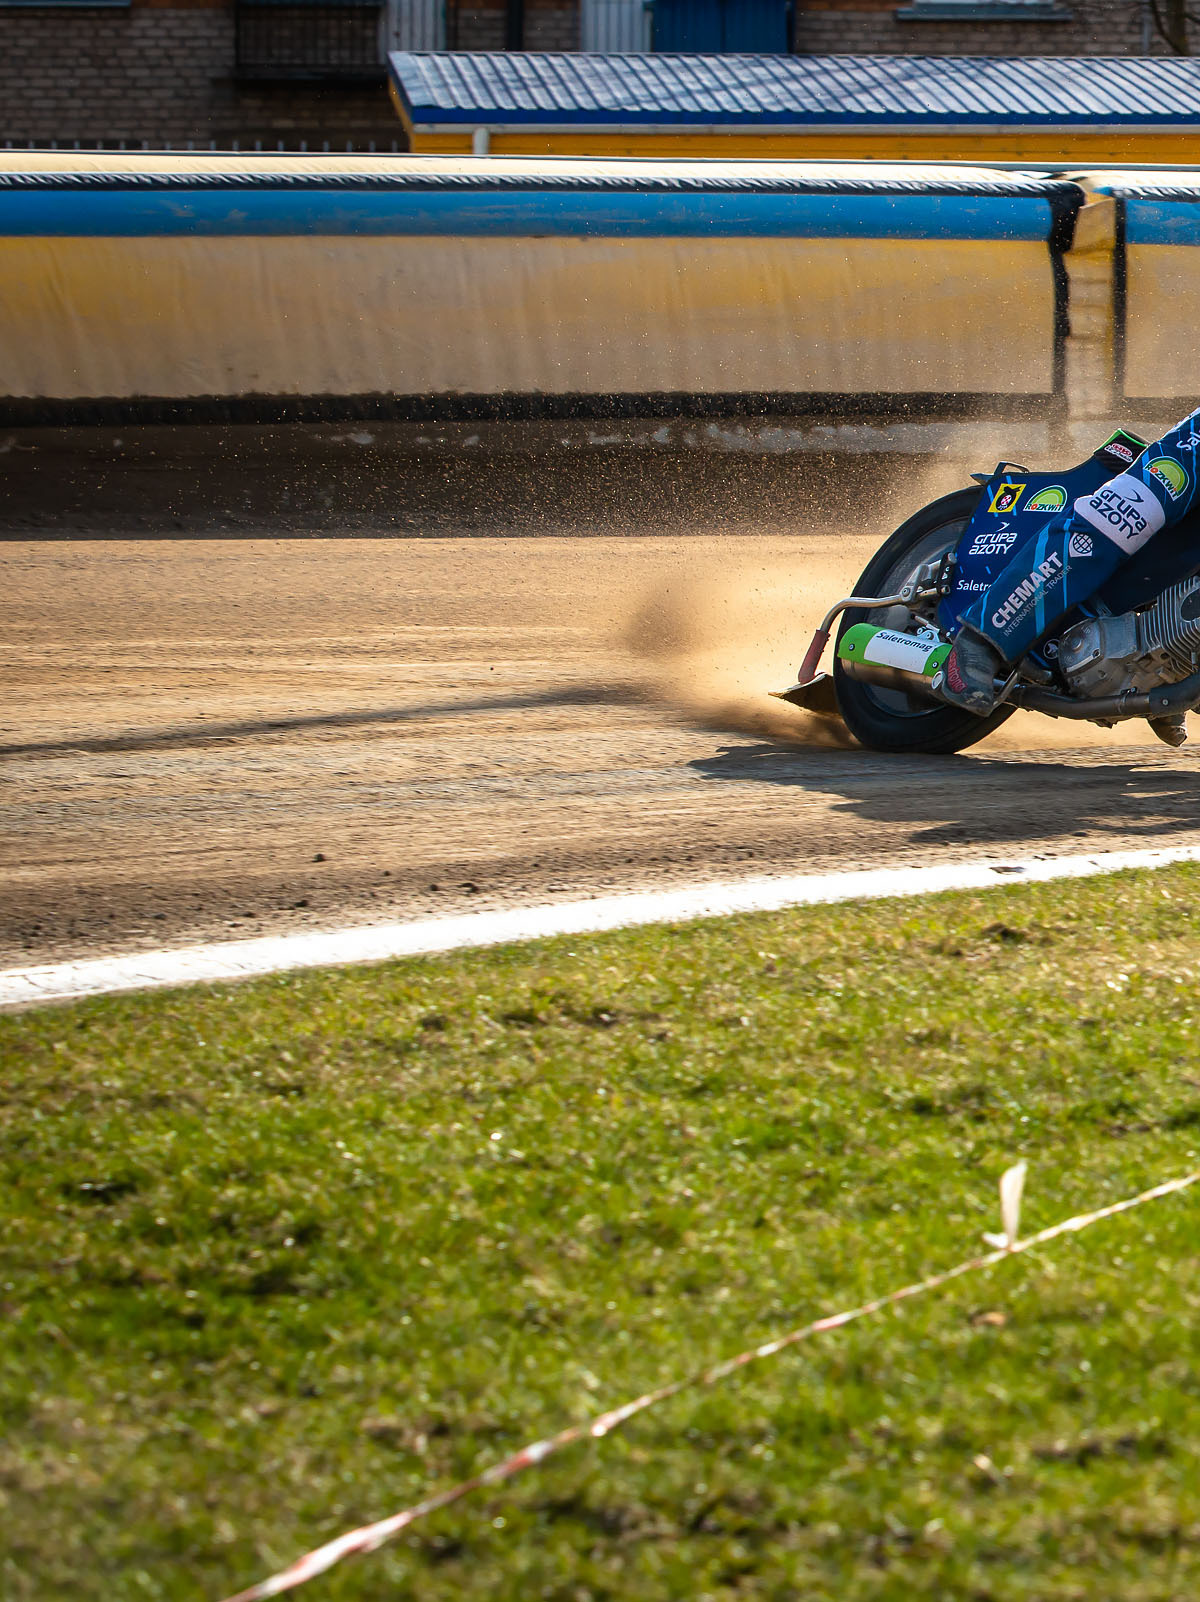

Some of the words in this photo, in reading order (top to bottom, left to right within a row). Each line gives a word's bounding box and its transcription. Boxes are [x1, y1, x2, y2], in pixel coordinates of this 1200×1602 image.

[992, 551, 1063, 628] CHEMART
[1003, 590, 1049, 637] INTERNATIONAL
[1046, 565, 1073, 589] TRADER
[876, 630, 934, 652] Saletromag
